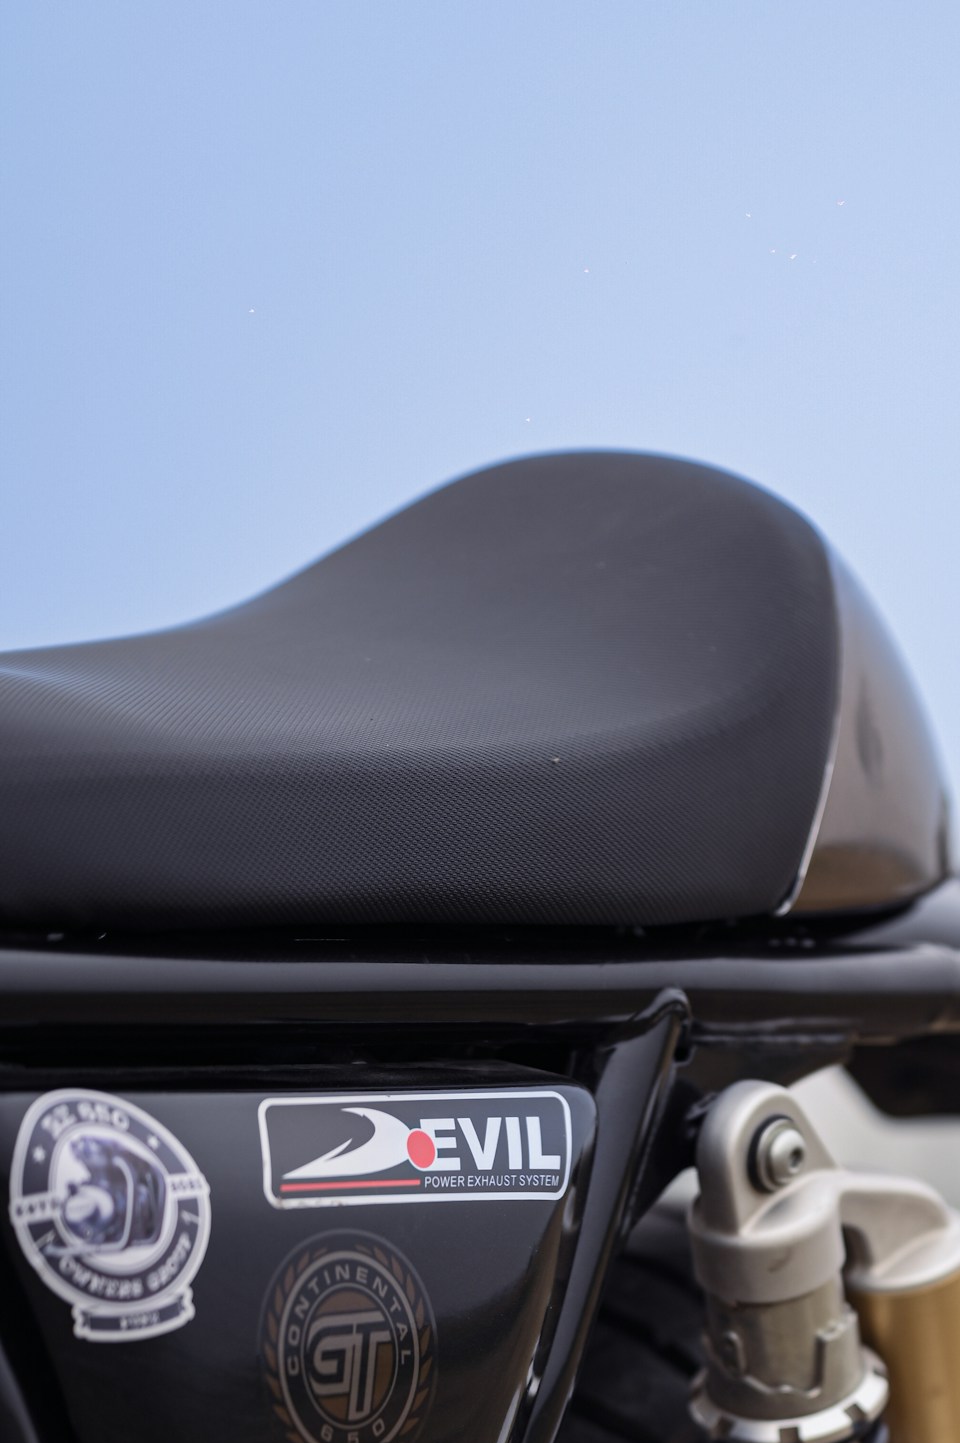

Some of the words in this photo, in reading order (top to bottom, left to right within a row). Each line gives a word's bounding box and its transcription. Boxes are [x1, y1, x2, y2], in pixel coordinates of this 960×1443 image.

[423, 1175, 466, 1189] POWER
[466, 1174, 518, 1188] EXHAUST
[518, 1173, 560, 1187] SYSTEM
[287, 1263, 412, 1377] CONTINENTAL
[306, 1310, 393, 1422] GT
